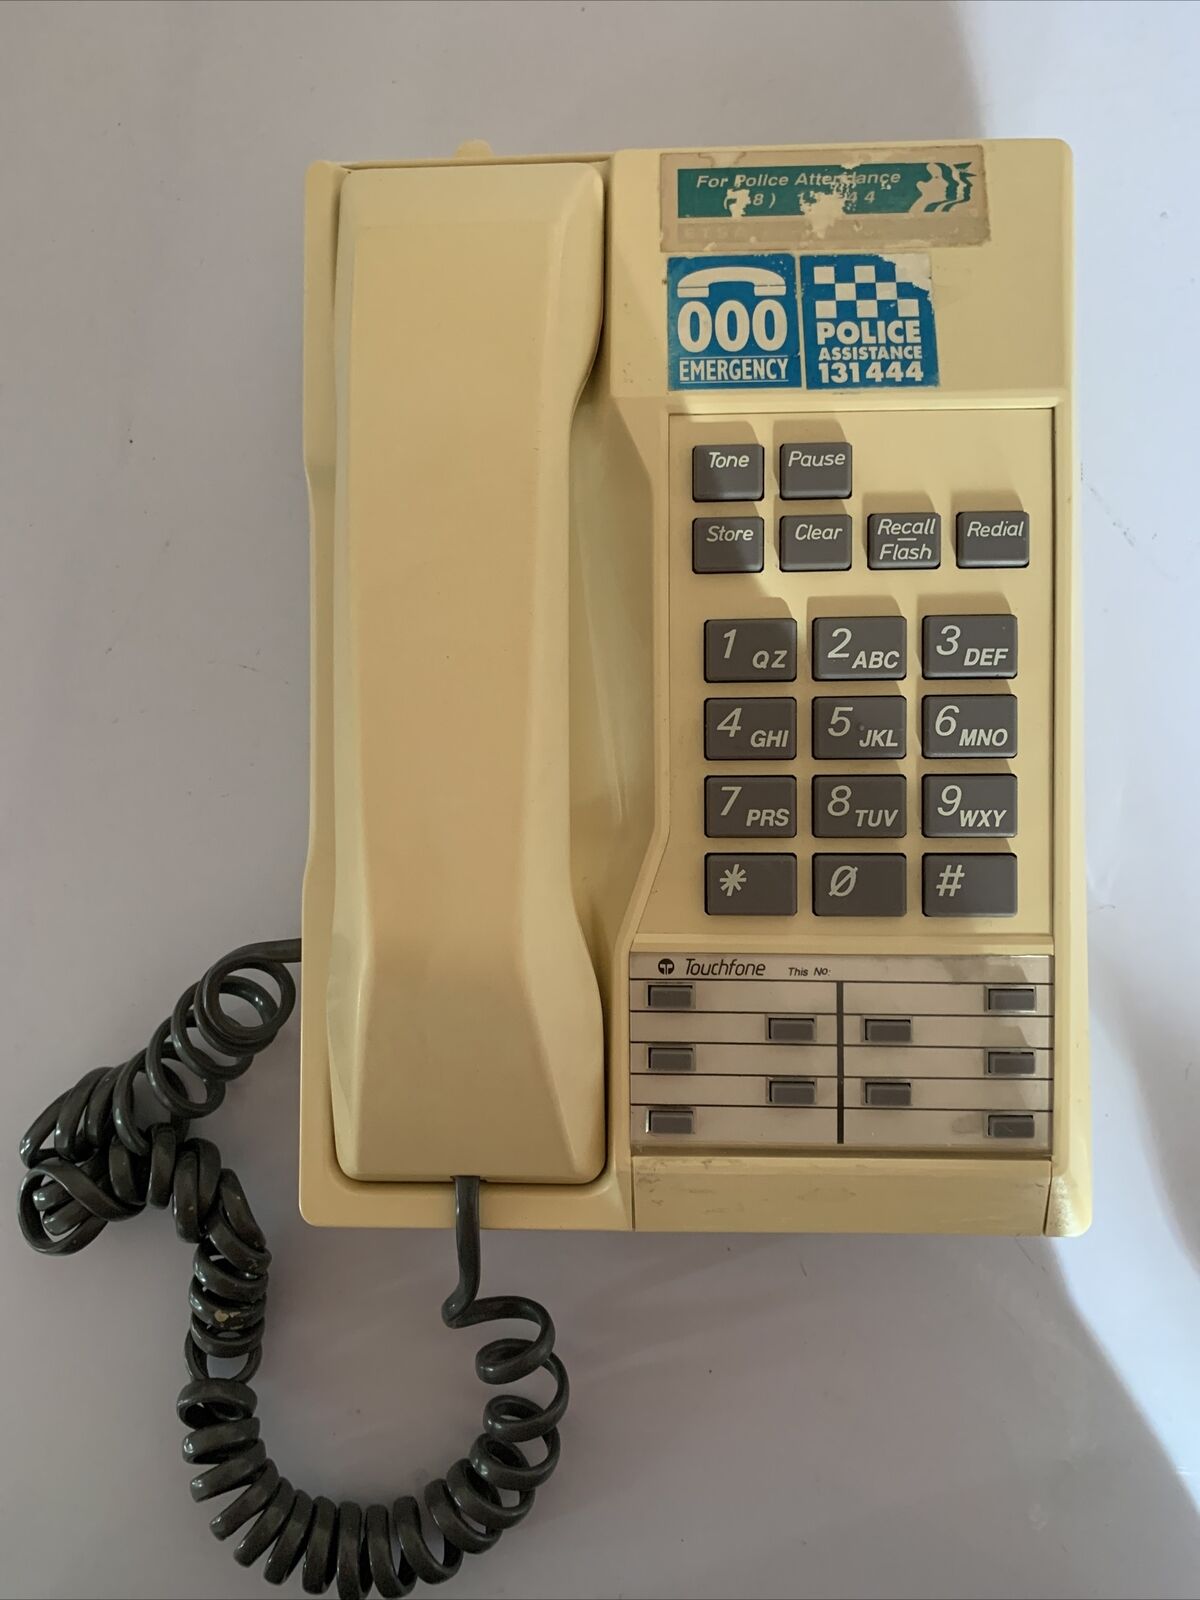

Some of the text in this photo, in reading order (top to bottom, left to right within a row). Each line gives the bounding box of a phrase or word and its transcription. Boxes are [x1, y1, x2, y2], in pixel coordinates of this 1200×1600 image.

[696, 171, 901, 188] For Police Attendance
[677, 299, 788, 352] 000
[816, 319, 922, 345] POLICE
[818, 345, 923, 361] ASSISTANCE
[679, 357, 789, 382] EMERGENCY
[818, 362, 924, 384] 131444
[708, 451, 750, 468] Tone
[788, 450, 846, 467] Pause
[706, 526, 754, 542] Store
[794, 523, 843, 540] Clear
[877, 518, 936, 536] Recall
[967, 520, 1025, 538] Redial
[879, 543, 932, 560] Flash
[723, 629, 788, 669] 1 QZ
[827, 627, 900, 669] 2 ABC
[936, 625, 1009, 666] 3 DEF
[717, 707, 789, 748] 4 GHI
[827, 706, 899, 748] 5 JKL
[934, 705, 1008, 746] 6 MNO
[720, 786, 790, 827] 7 PRS
[827, 785, 899, 827] 8 TUV
[937, 785, 1007, 827] 9 WXY
[936, 864, 965, 897] #
[685, 958, 766, 977] Touchfone
[788, 967, 809, 977] This
